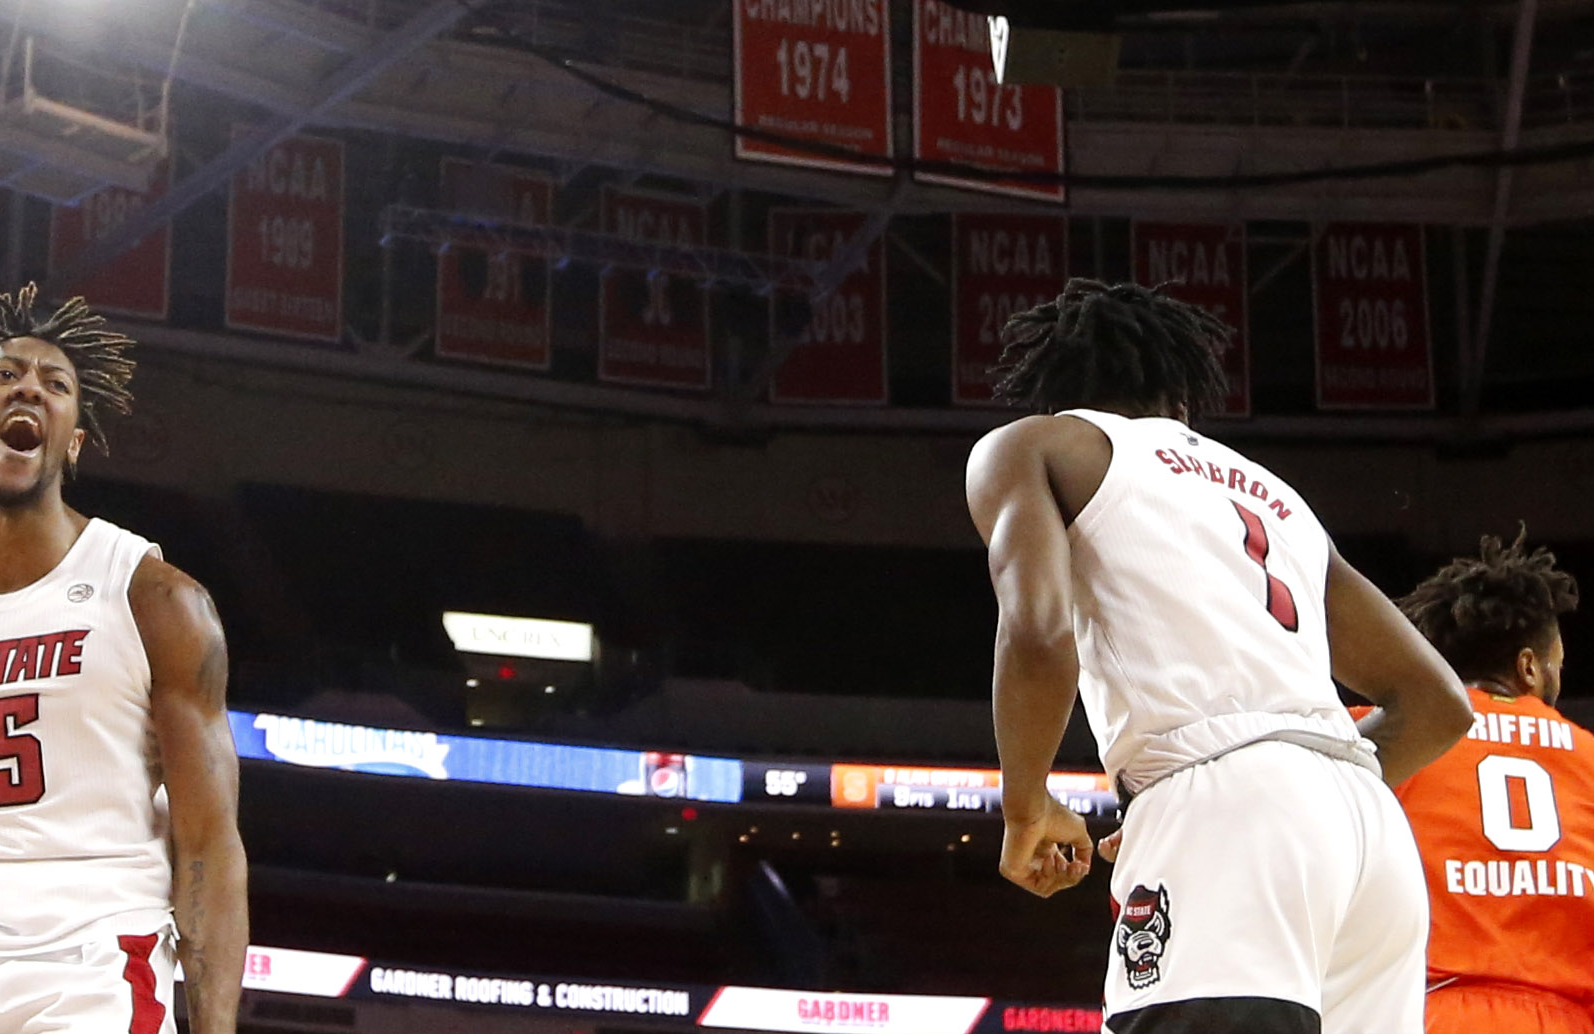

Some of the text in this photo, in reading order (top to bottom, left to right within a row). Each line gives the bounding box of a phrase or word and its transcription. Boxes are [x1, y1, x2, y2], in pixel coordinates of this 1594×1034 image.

[776, 37, 851, 104] 1974
[952, 65, 1024, 132] 1973
[969, 228, 1053, 276] NCAA
[1148, 240, 1231, 288] NCAA
[1327, 234, 1410, 281] NCAA
[803, 293, 866, 344] 003
[1340, 298, 1408, 349] 2006
[1228, 498, 1299, 634] 1
[1465, 712, 1574, 751] RIFFIN
[1476, 754, 1562, 853] 0
[370, 967, 690, 1016] GARDNER ROOFING & CONSTRUCTION
[797, 998, 890, 1024] GARDNER
